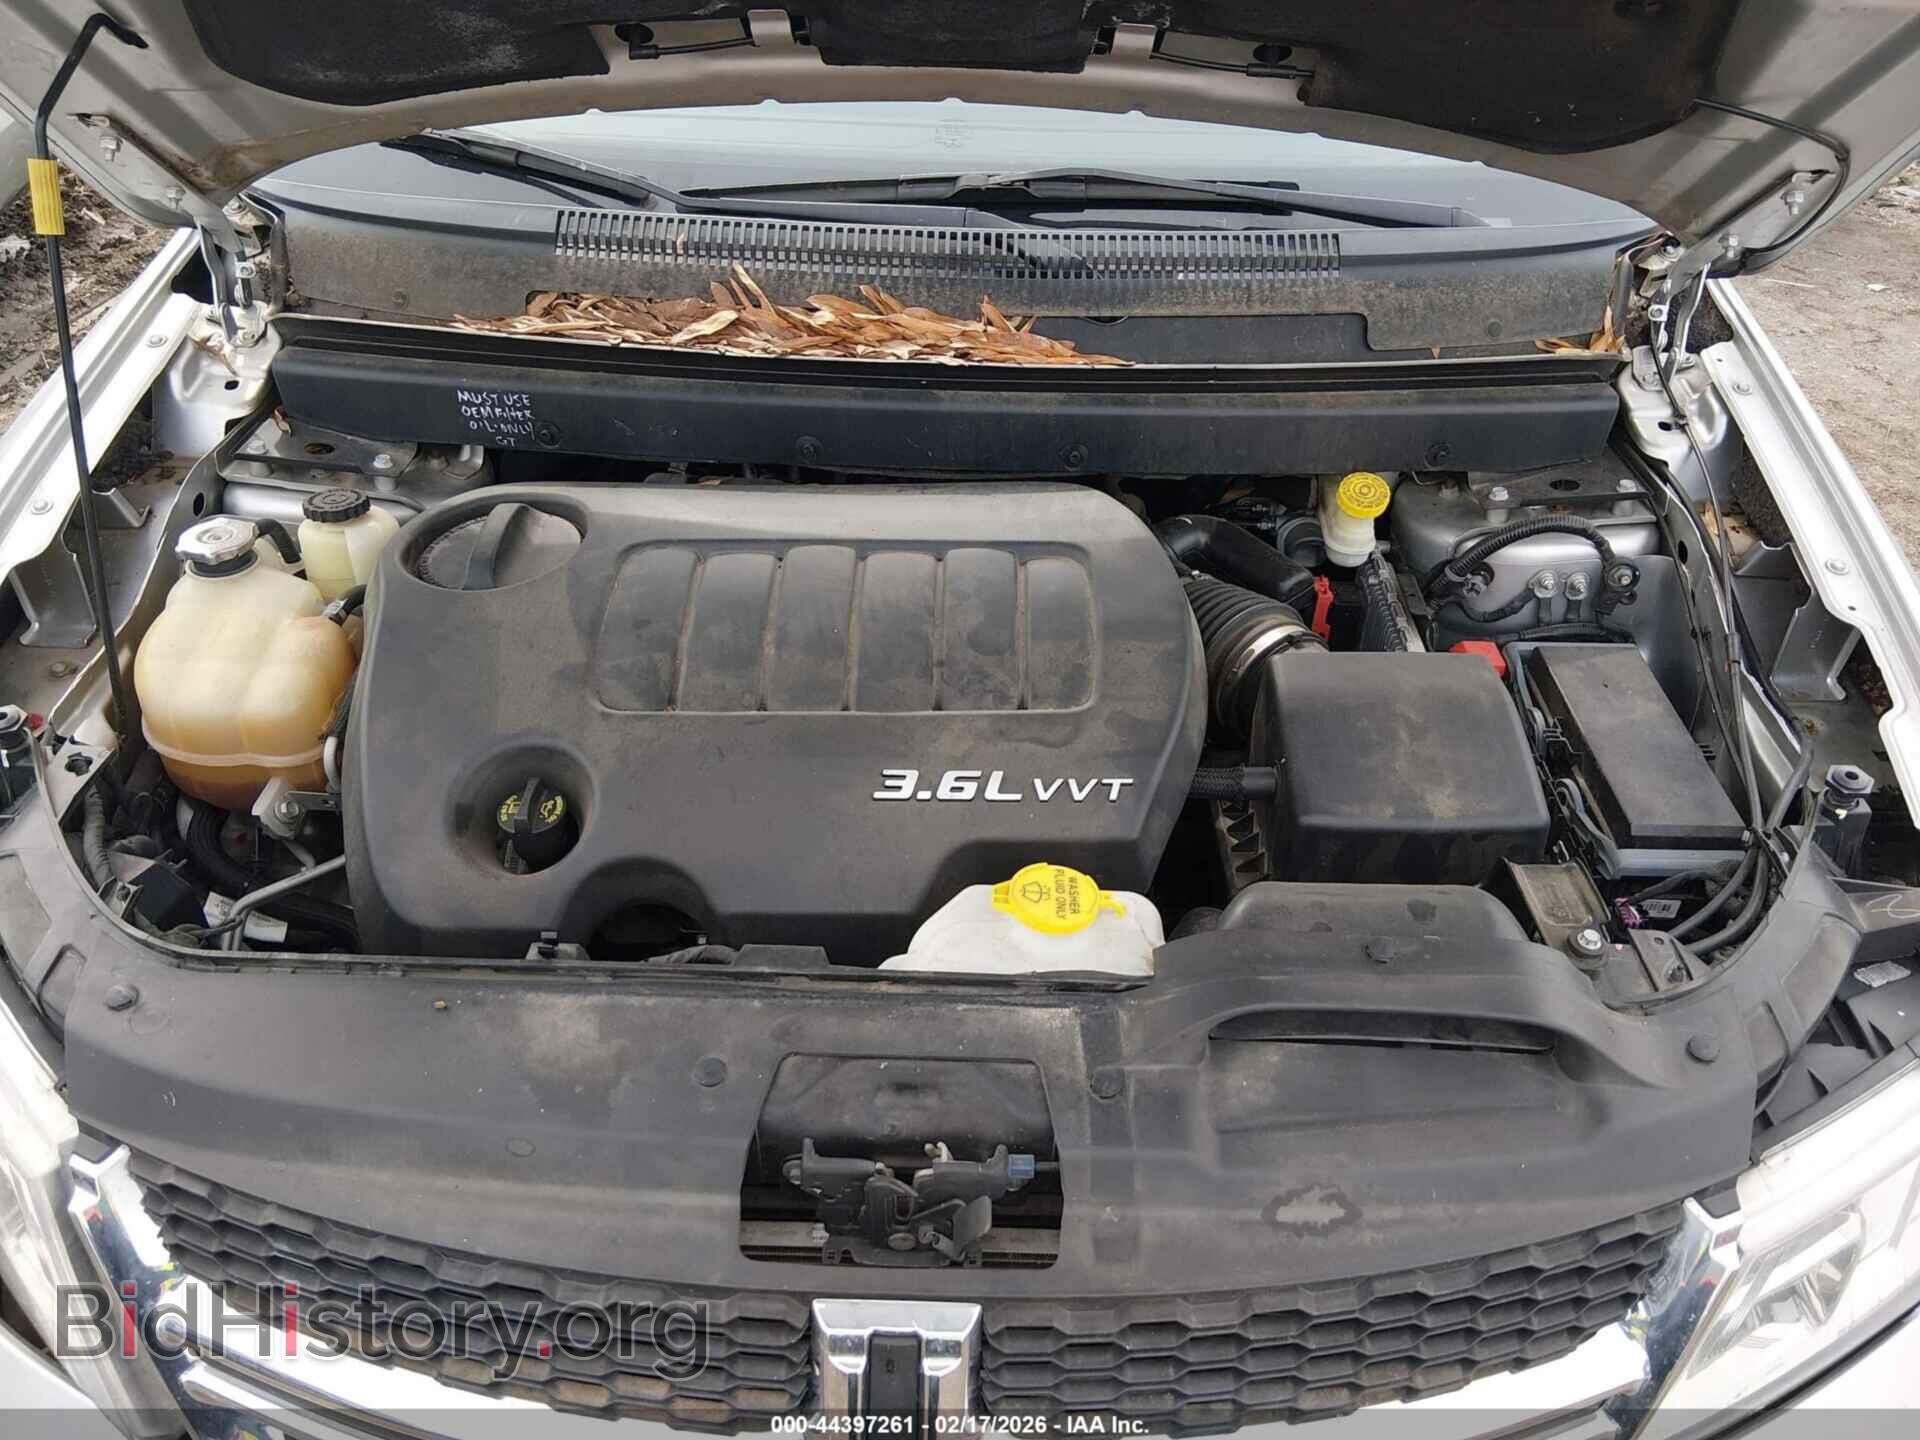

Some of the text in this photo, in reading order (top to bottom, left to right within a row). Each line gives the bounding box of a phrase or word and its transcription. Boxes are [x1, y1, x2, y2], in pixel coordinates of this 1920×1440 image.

[457, 390, 530, 407] MUST USE
[872, 769, 1134, 802] 3.6L VVT
[1054, 868, 1068, 920] FLUID ONLY
[1067, 876, 1081, 915] WASHER
